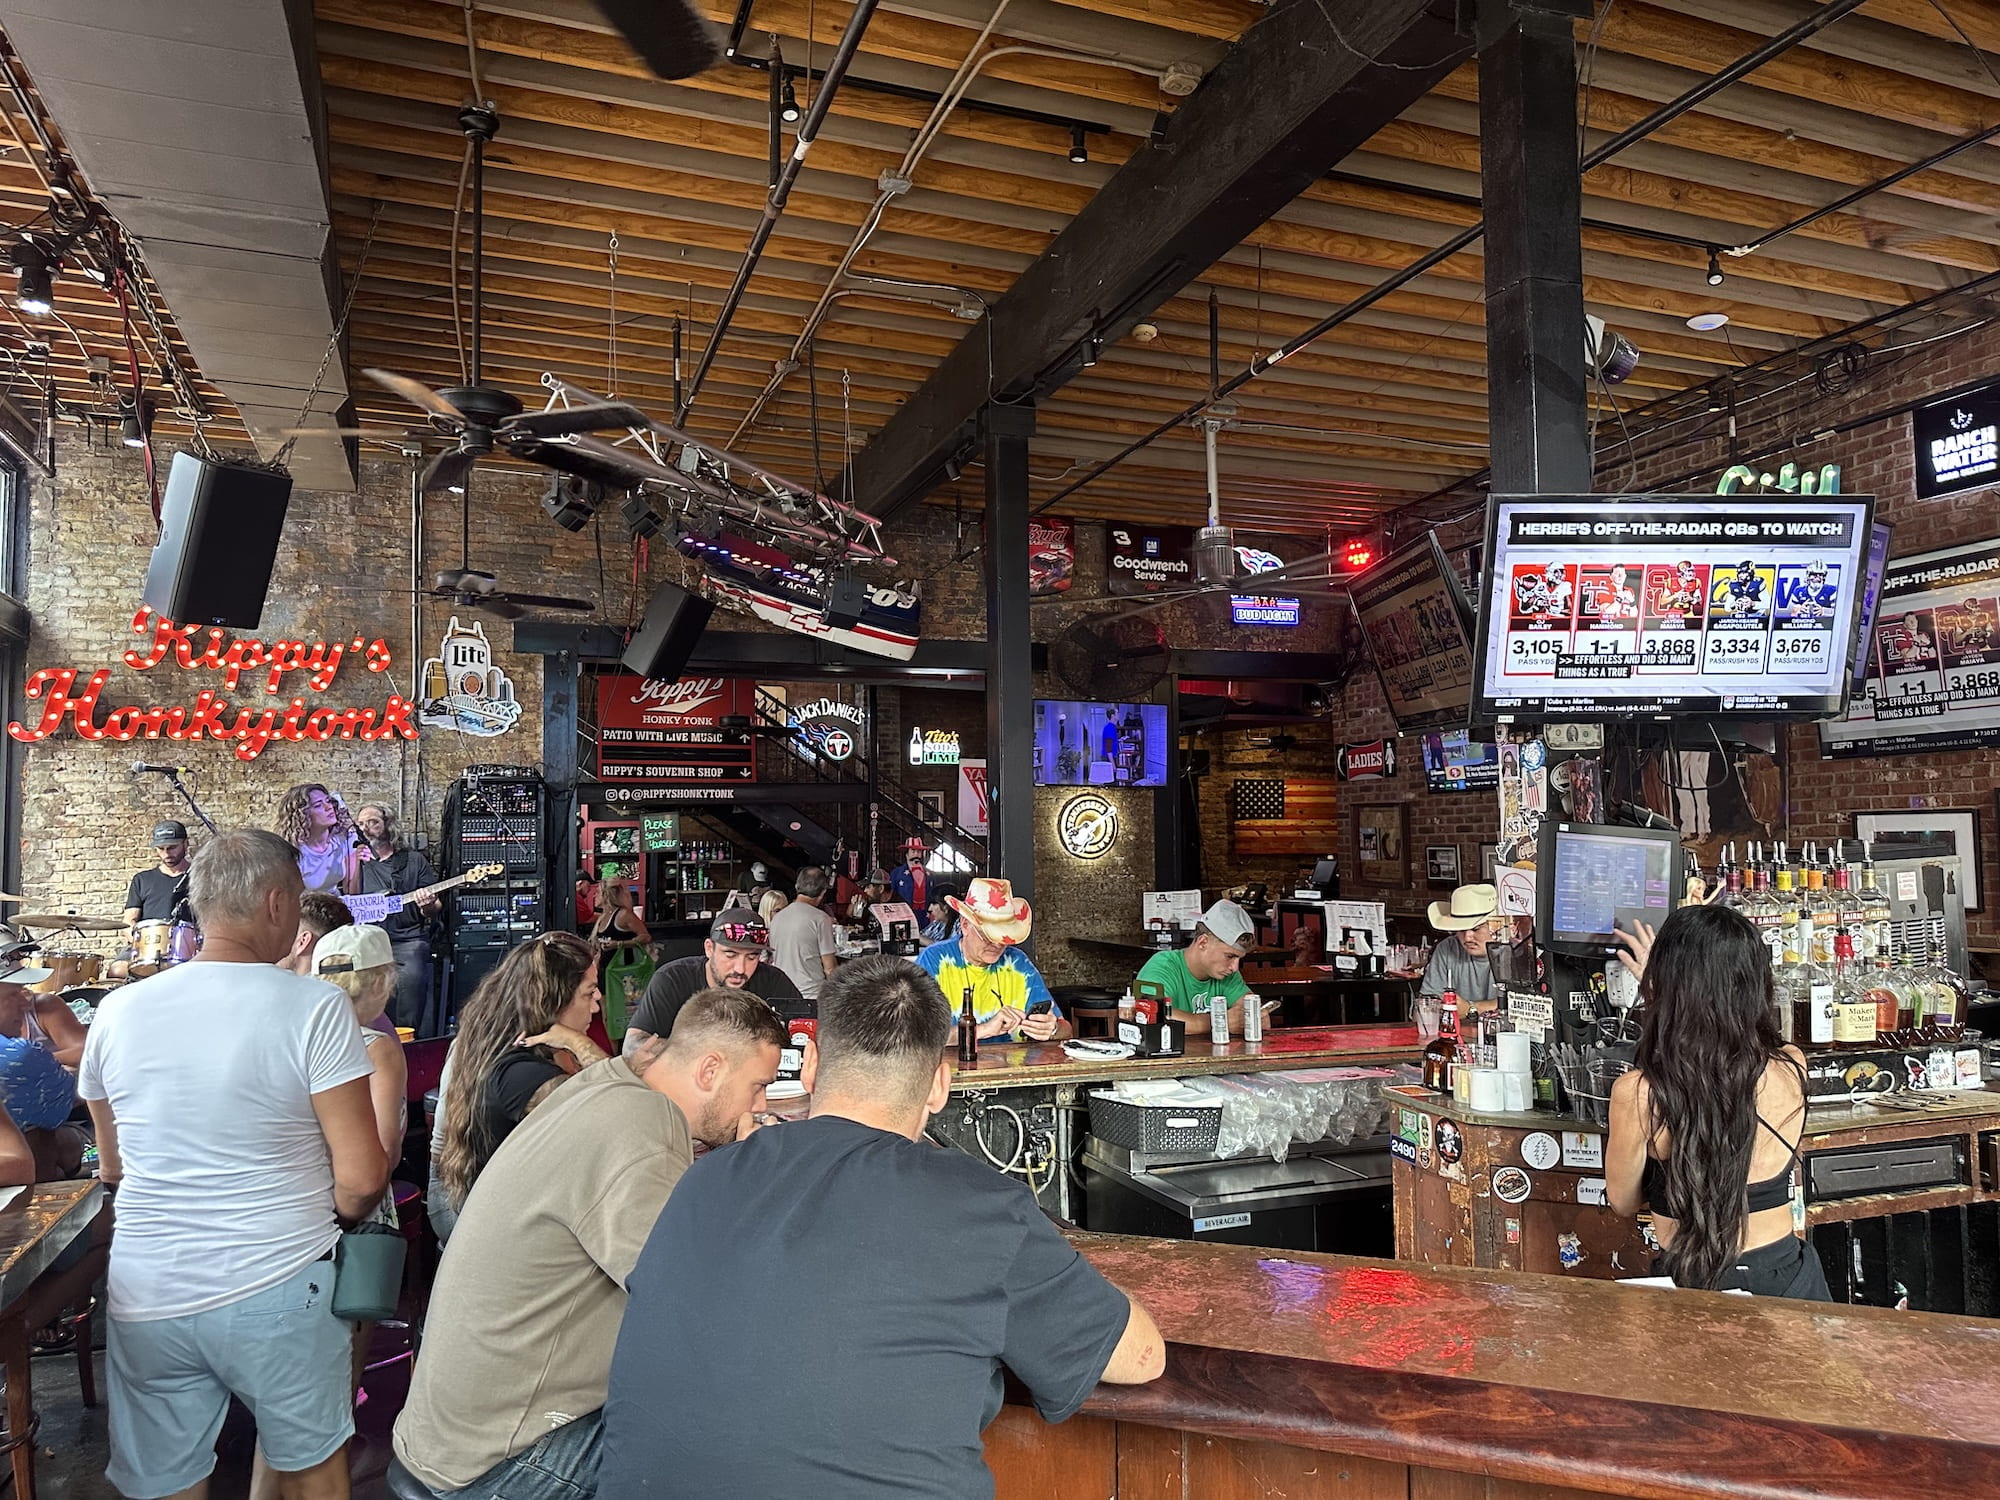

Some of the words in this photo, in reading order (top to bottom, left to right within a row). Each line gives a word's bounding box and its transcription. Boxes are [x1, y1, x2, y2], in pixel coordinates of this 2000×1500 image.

[1930, 425, 1997, 457] RANCH
[1931, 443, 1999, 473] WATER
[1029, 523, 1070, 543] Bud
[1518, 523, 1590, 536] HERBIE'S
[1594, 523, 1722, 536] OFF-THE-RADAR
[1727, 523, 1758, 537] QBs
[1762, 523, 1780, 535] TO
[1786, 523, 1843, 535] WATCH
[1113, 530, 1132, 546] 3
[1146, 540, 1157, 550] GM
[1113, 555, 1188, 573] Goodwrench
[1134, 570, 1167, 582] Service
[1884, 557, 1999, 590] OFF-THE-RADAR
[1254, 599, 1277, 608] BAR
[1236, 609, 1260, 621] BUD
[1262, 609, 1296, 622] LIGHT
[123, 604, 392, 694] Rippy's
[1513, 640, 1563, 657] 3,105
[1590, 640, 1619, 654] 1-1
[1646, 640, 1695, 654] 3,868
[1711, 639, 1760, 656] 3,334
[1776, 639, 1821, 656] 3,676
[452, 645, 486, 668] Lite
[1575, 655, 1623, 664] EFFORTLESS
[1624, 655, 1641, 664] AND
[1642, 655, 1657, 664] DID
[1657, 655, 1668, 664] SO
[1670, 655, 1692, 664] MANY
[1558, 667, 1588, 677] THINGS
[1588, 667, 1599, 677] AS
[1600, 667, 1606, 677] A
[1607, 667, 1628, 677] TRUE
[1951, 671, 1999, 690] 3,868
[630, 678, 725, 705] Rippy's
[1900, 680, 1927, 696] 1-1
[1889, 694, 1932, 706] EFFORTLESS
[1933, 692, 1949, 702] AND
[1950, 690, 1964, 700] DID
[1965, 688, 1976, 698] SO
[1977, 686, 1999, 697] MANY
[7, 668, 420, 761] Honkytonk
[794, 702, 822, 724] JACK
[820, 698, 866, 725] DANIEL'S
[1877, 709, 1903, 720] THINGS
[1904, 708, 1914, 717] AS
[1914, 708, 1920, 716] A
[1921, 705, 1940, 715] TRUE
[642, 715, 681, 725] HONKY
[683, 716, 713, 725] TONK
[603, 730, 633, 741] PATIO
[635, 731, 664, 742] WITH
[666, 733, 689, 742] LIVE
[690, 733, 723, 743] MUSIC
[924, 730, 960, 743] Tito's
[924, 742, 960, 752] SODA
[1832, 741, 1853, 749] ESPN
[925, 752, 960, 764] LIME
[1348, 752, 1383, 769] LADIES
[603, 766, 643, 776] RIPPY'S
[645, 767, 696, 777] SOUVENIR
[697, 768, 724, 777] SHOP
[631, 789, 735, 801] @RIPPYSHONKYTONK
[644, 819, 673, 831] PLEASE
[1507, 821, 1523, 834] 831
[645, 832, 664, 841] SEAT
[650, 840, 678, 850] YOURSELF
[1514, 893, 1529, 907] Pay
[353, 909, 386, 922] THOMAS
[1513, 1000, 1546, 1013] BARTENDER
[1391, 1139, 1416, 1159] 2490
